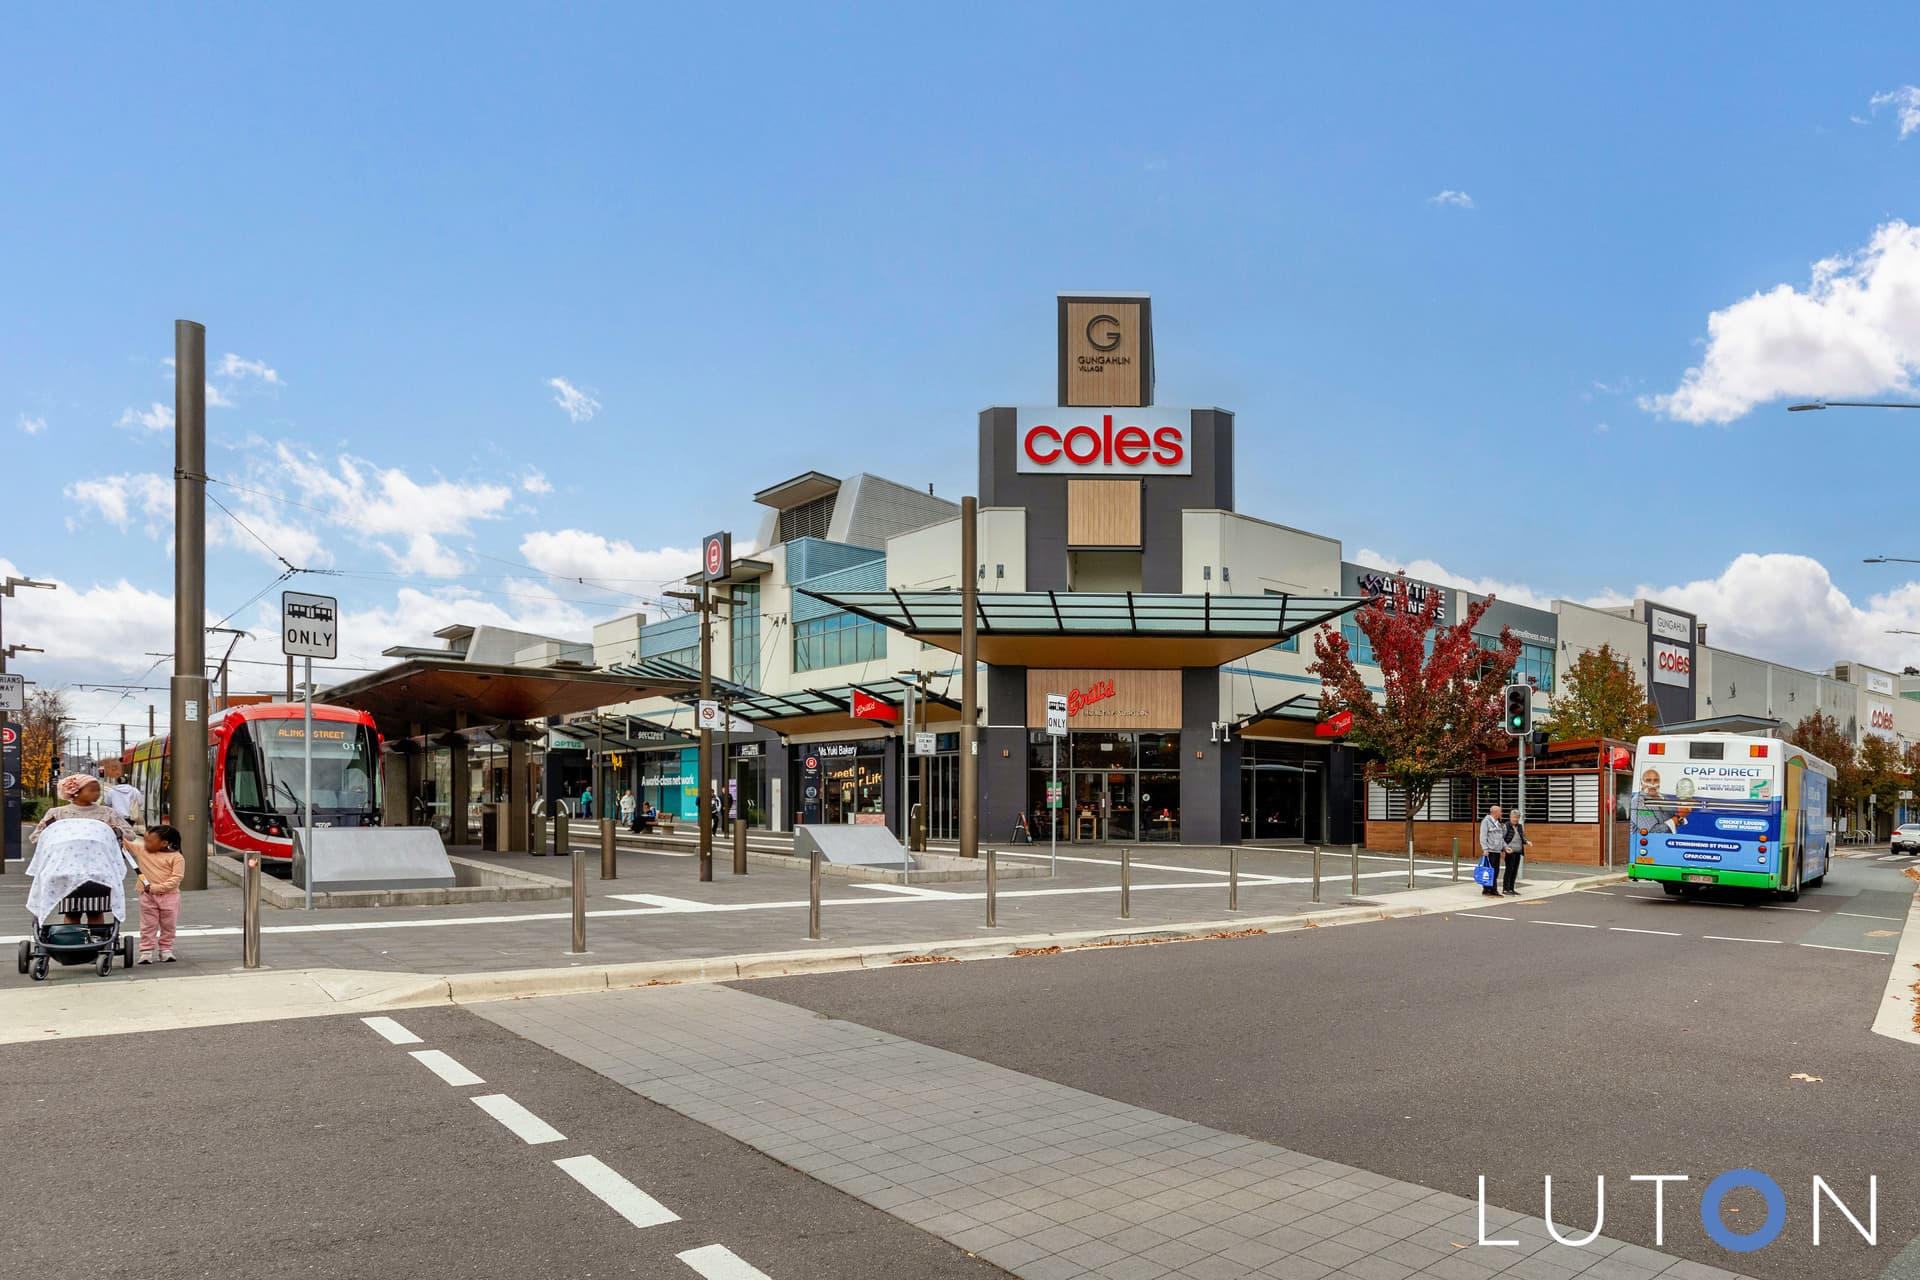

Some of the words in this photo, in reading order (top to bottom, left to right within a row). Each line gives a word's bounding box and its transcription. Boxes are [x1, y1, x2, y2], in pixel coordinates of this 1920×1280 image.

[1086, 314, 1121, 351] G
[1078, 355, 1131, 365] GUNGAHLIN
[1078, 365, 1104, 373] VILLAGE
[1024, 414, 1184, 466] coles
[1657, 616, 1687, 633] GUNGAHLIN
[287, 628, 333, 647] ONLY
[1658, 648, 1690, 674] coles
[1067, 678, 1116, 717] Grill'd
[856, 702, 876, 716] Grill'd
[1048, 717, 1066, 728] ONLY
[1871, 706, 1894, 731] coles
[278, 728, 305, 738] ALING
[313, 730, 345, 739] STREET
[342, 742, 362, 751] 011
[554, 740, 582, 748] OPTUS
[838, 744, 857, 757] Bakery
[1683, 766, 1716, 776] CPAP
[1718, 767, 1762, 777] DIRECT
[641, 776, 646, 787] A
[646, 774, 673, 786] world-class
